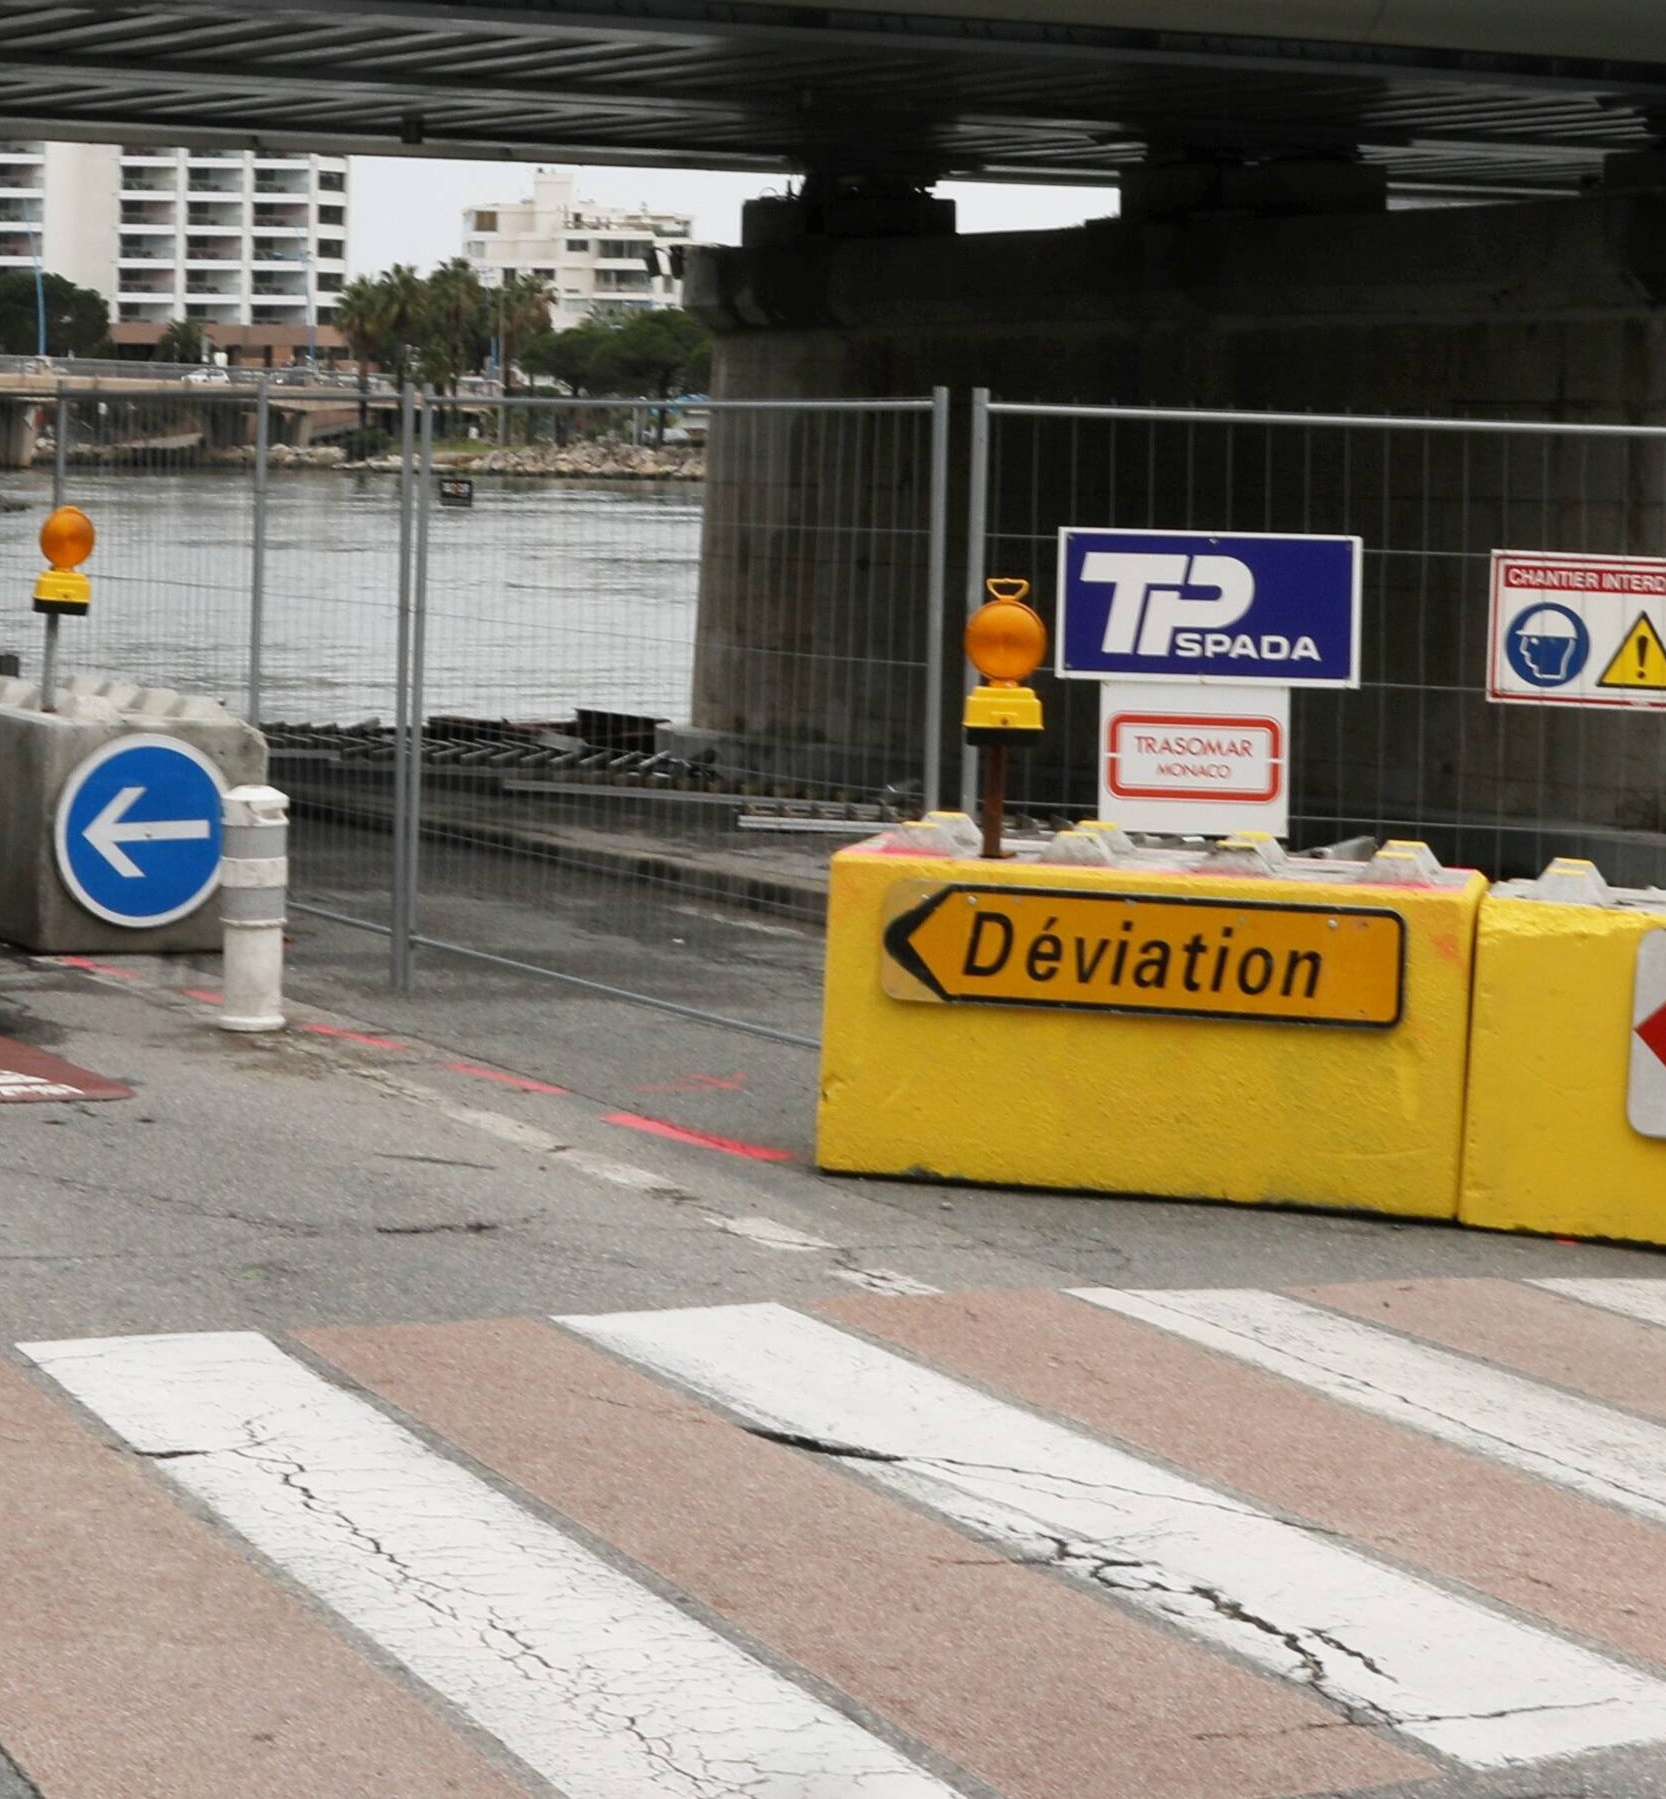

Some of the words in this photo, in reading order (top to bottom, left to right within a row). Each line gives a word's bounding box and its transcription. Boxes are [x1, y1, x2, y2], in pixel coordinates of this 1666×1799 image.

[1508, 567, 1598, 590] CHANTIER
[1079, 551, 1256, 657] TP
[1174, 632, 1322, 662] SPADA
[1135, 735, 1253, 757] TRASOMAR
[1156, 763, 1231, 779] MONACO
[962, 910, 1324, 999] Déviation
